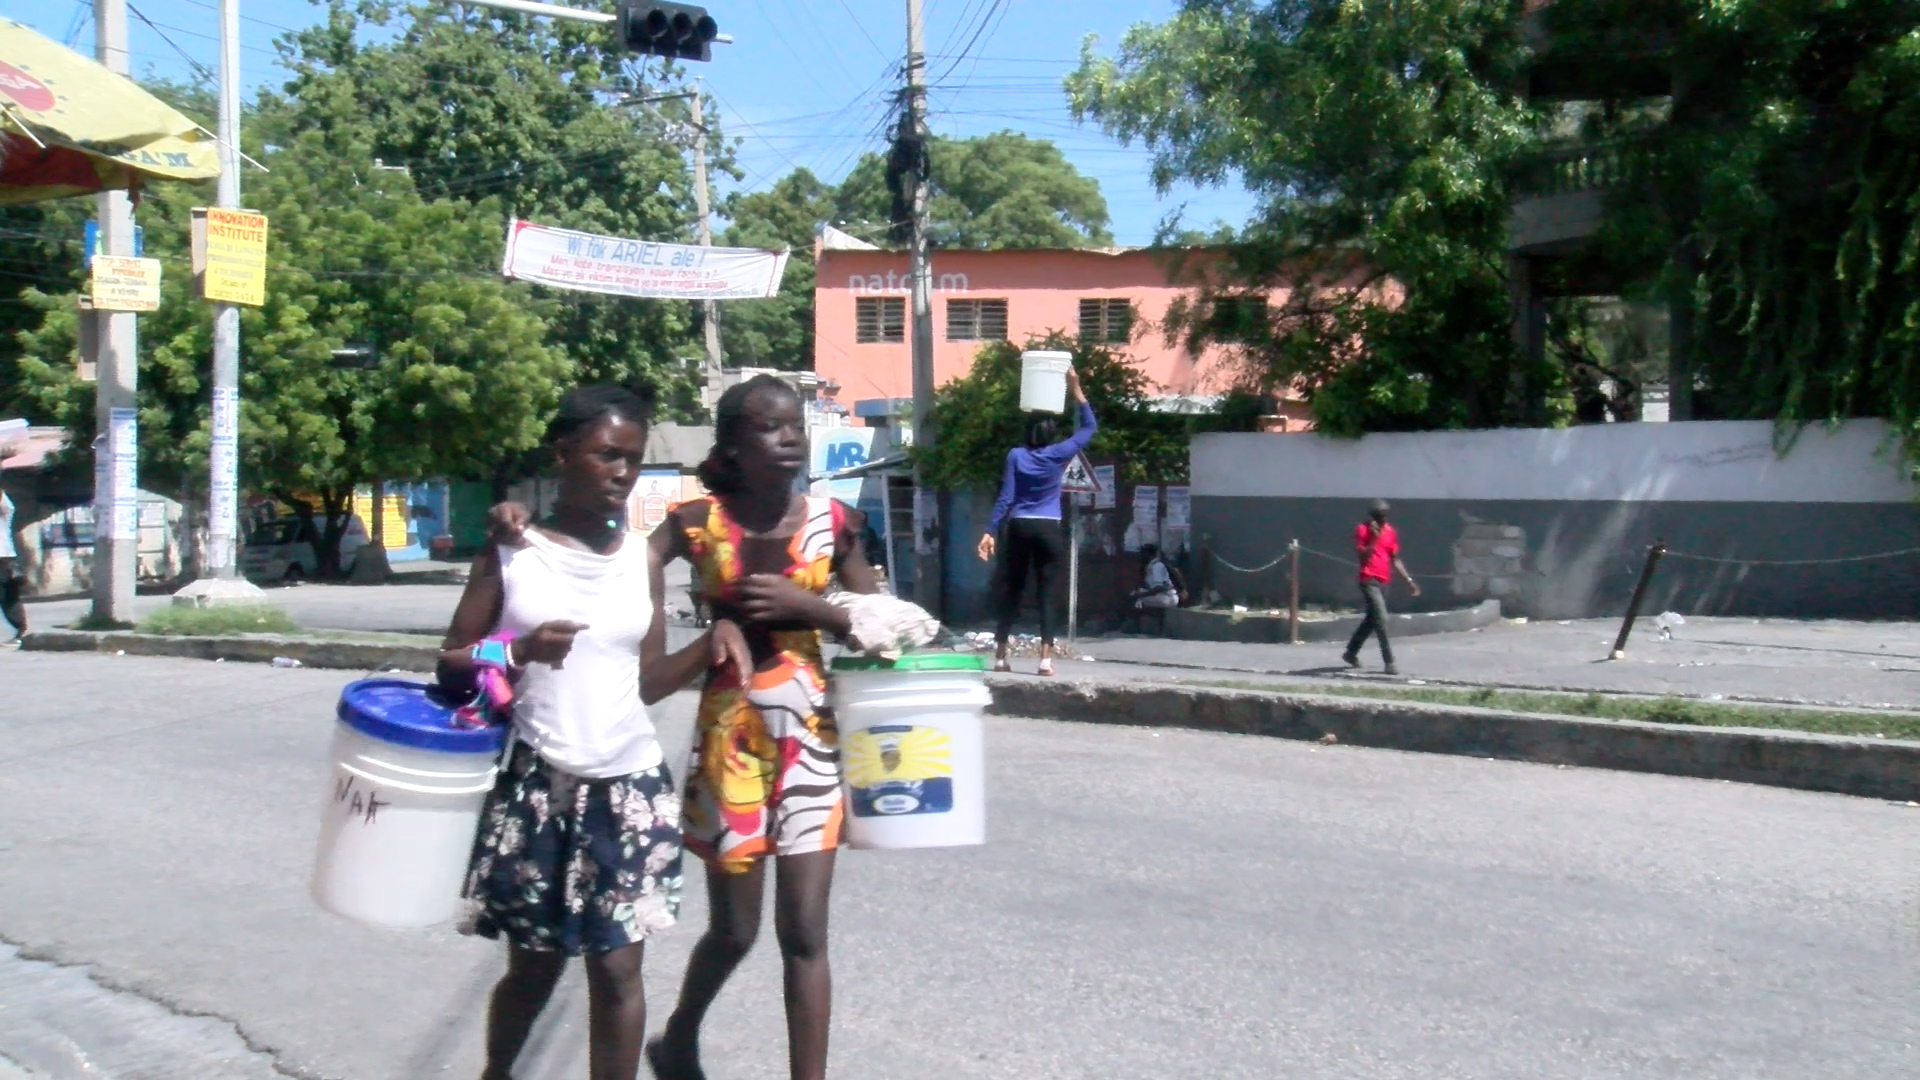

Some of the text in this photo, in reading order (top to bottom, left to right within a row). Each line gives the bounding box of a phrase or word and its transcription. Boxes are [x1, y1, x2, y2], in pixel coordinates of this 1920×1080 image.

[208, 210, 265, 228] INNOVATION
[208, 224, 264, 243] INSTITUTE
[611, 241, 664, 265] ARIEL
[671, 247, 695, 267] ale
[848, 269, 968, 294] natcm
